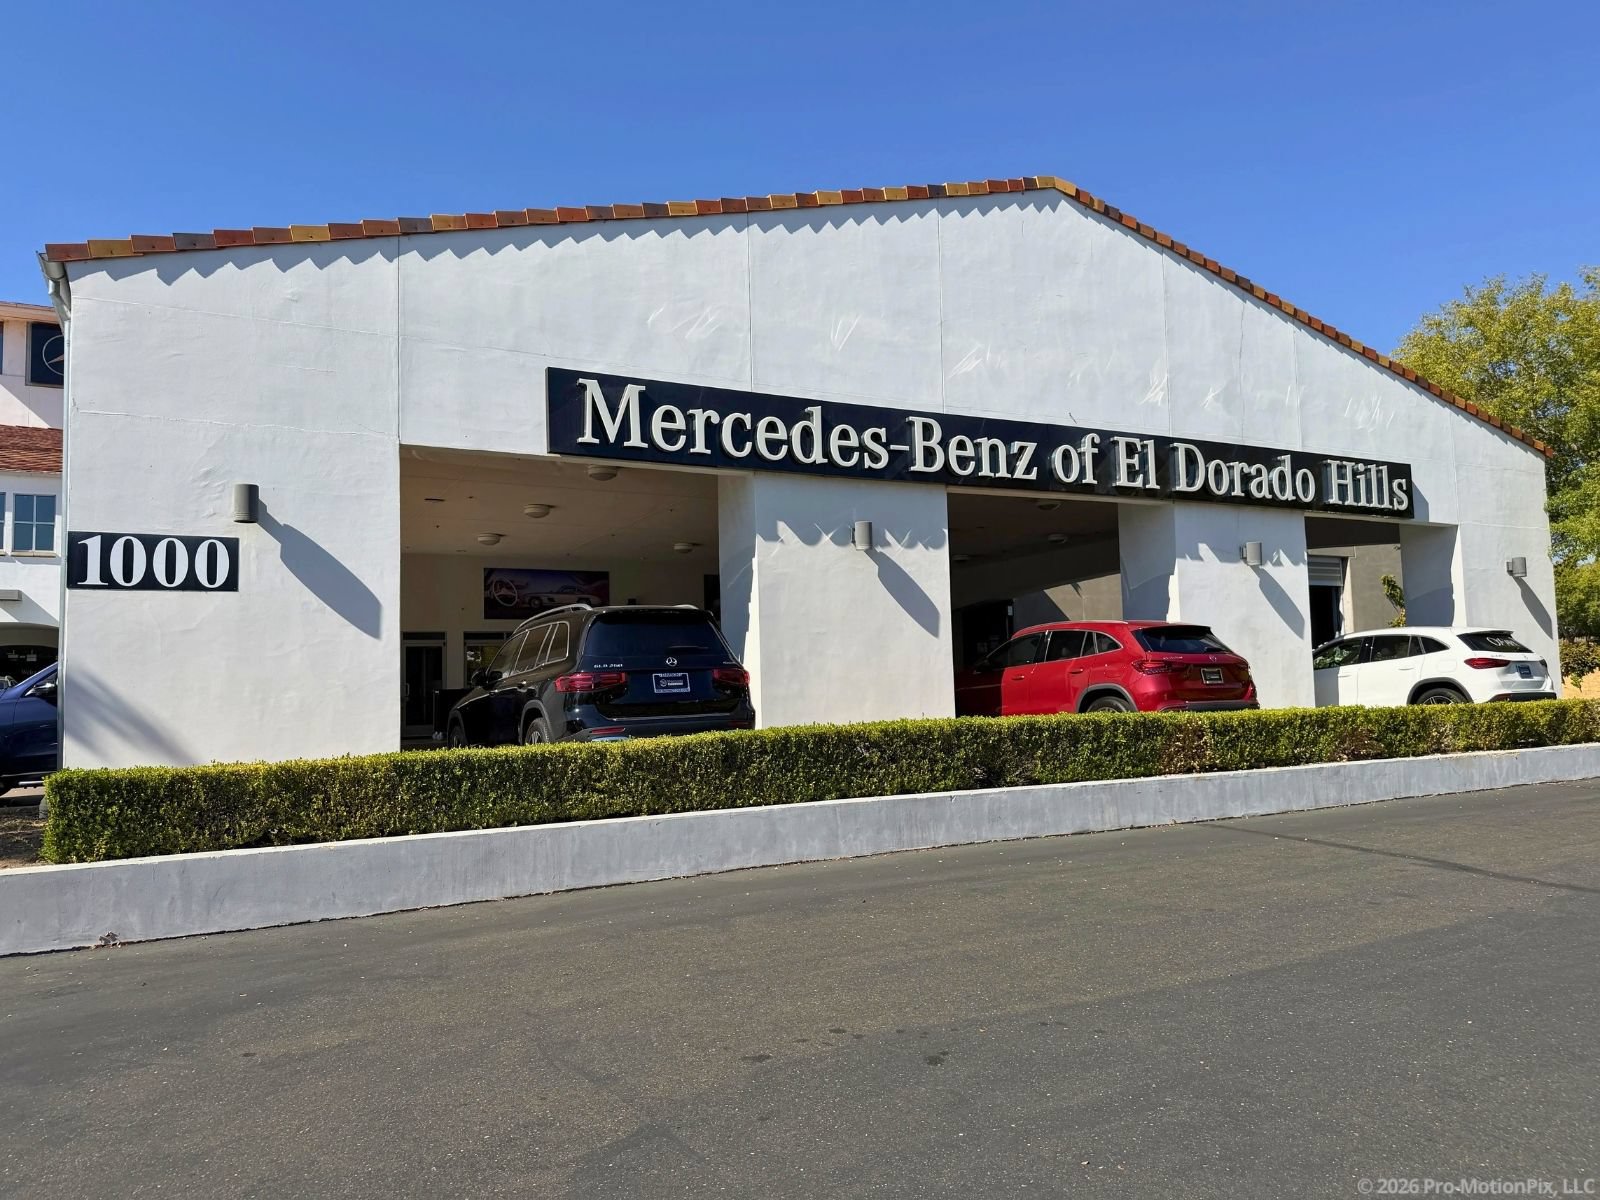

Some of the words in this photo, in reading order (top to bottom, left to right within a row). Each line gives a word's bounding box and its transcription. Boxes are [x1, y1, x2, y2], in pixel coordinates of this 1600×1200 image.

[576, 377, 1038, 481] Mercedes-Benz
[1052, 432, 1101, 485] of
[1111, 436, 1161, 490] El
[1171, 442, 1316, 503] Dorado
[1325, 459, 1410, 511] Hills
[77, 534, 230, 588] 1000
